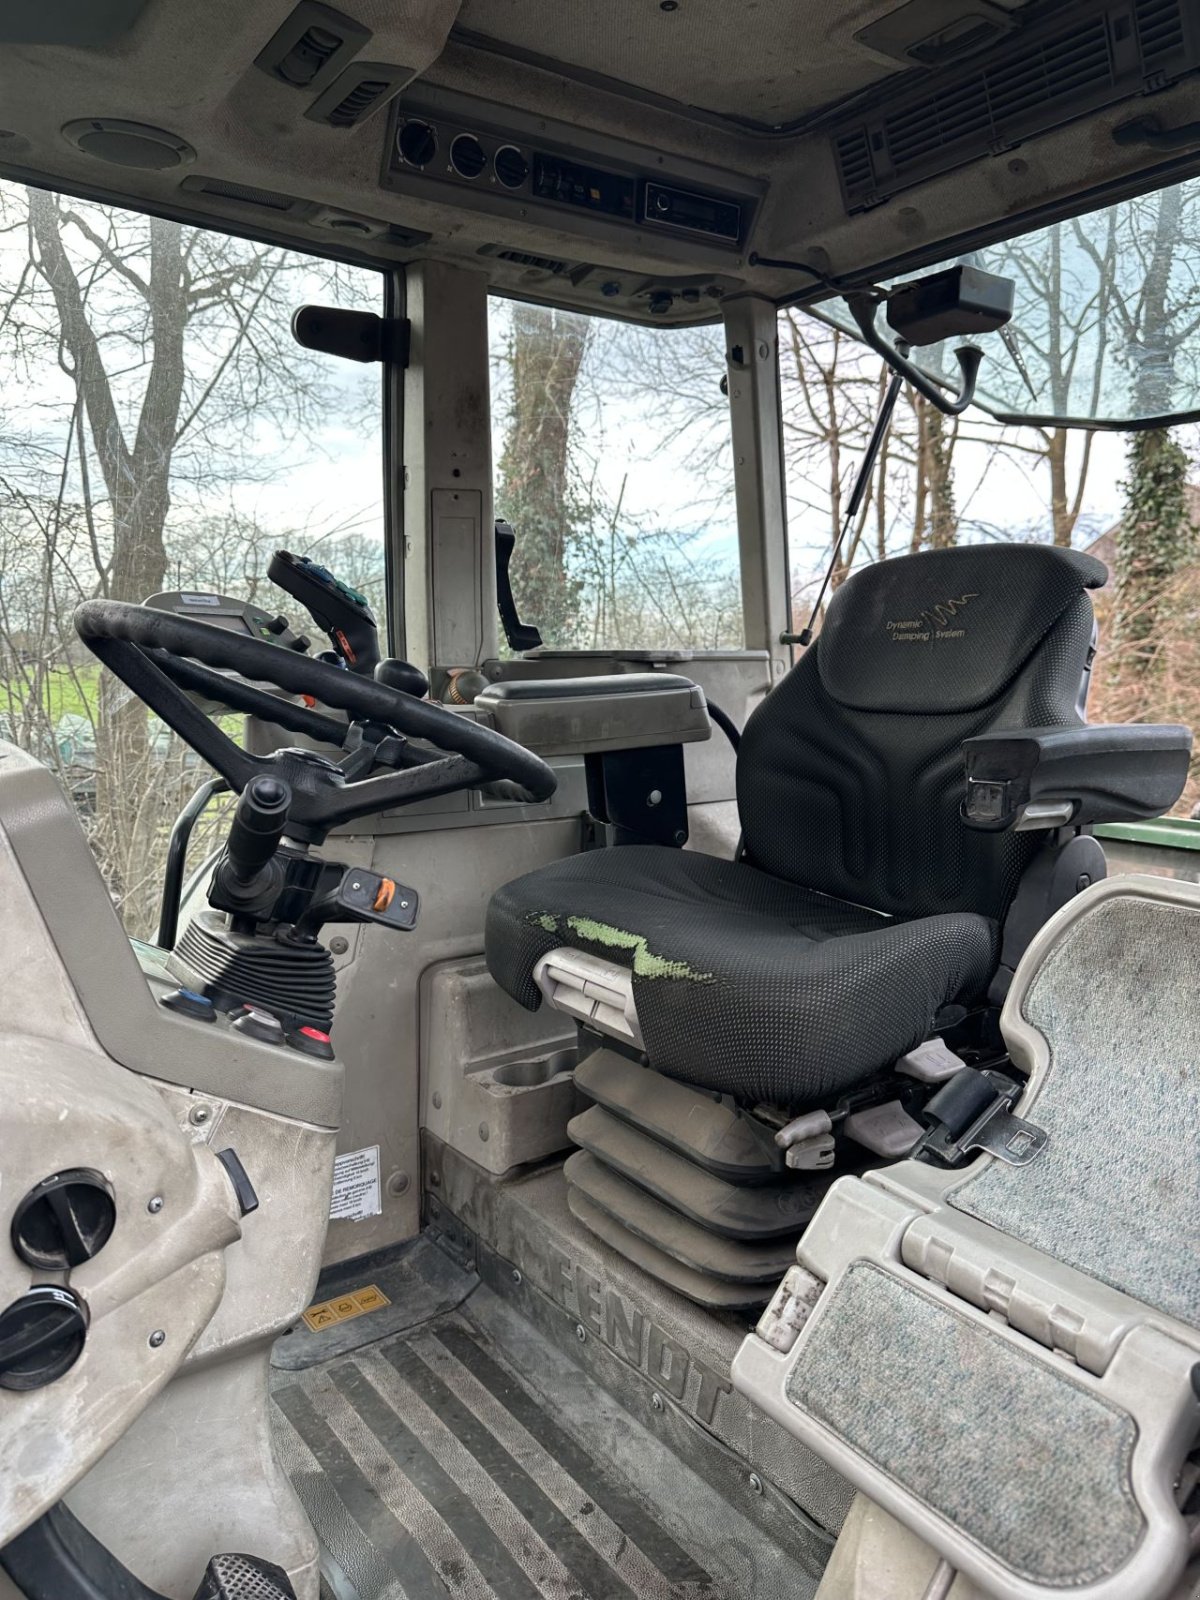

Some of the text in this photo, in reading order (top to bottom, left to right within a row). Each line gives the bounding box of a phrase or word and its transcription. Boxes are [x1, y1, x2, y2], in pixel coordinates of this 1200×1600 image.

[886, 620, 923, 630] Dynamic
[893, 631, 930, 641] Damping
[549, 1240, 733, 1425] FENDT
